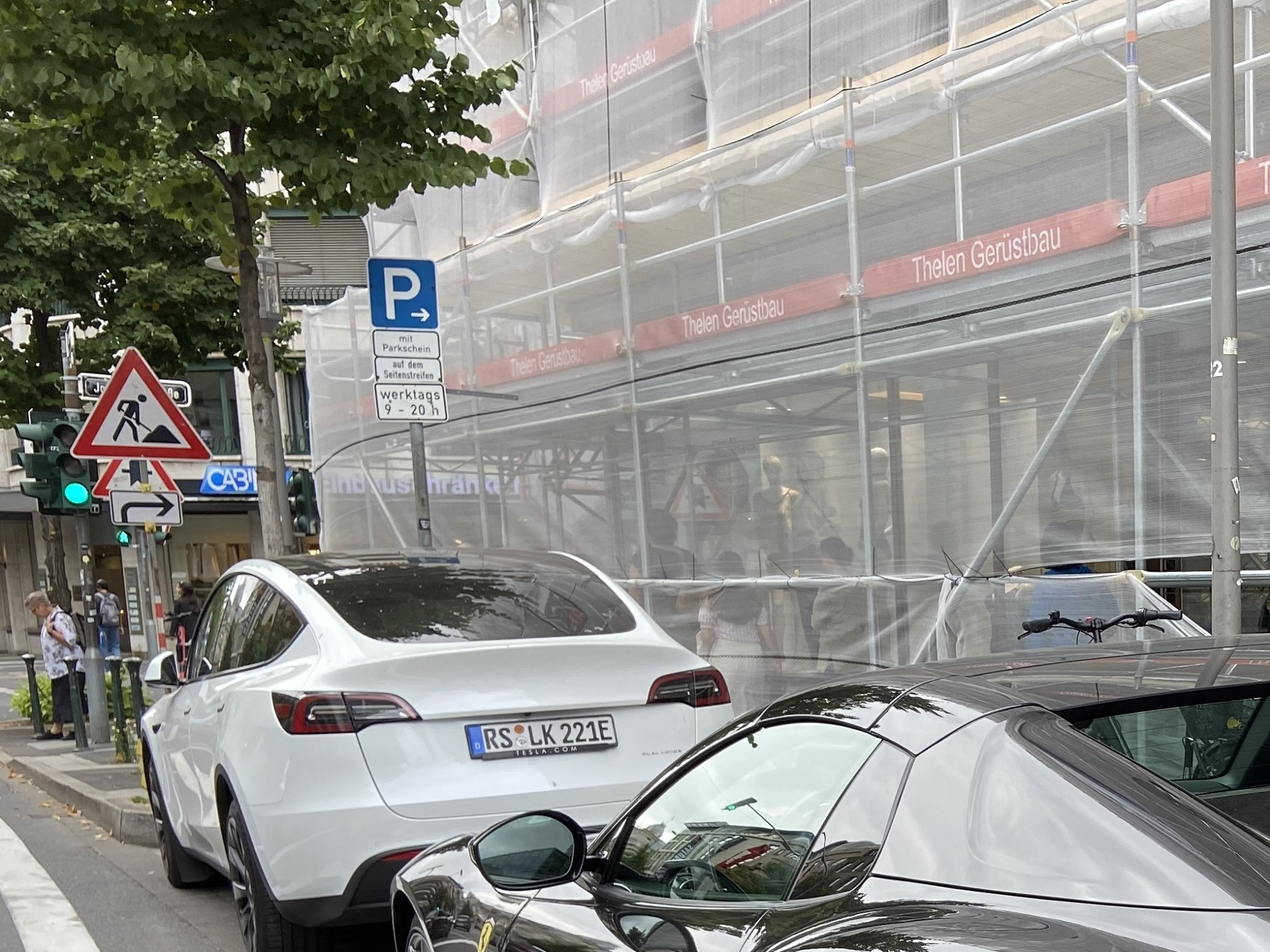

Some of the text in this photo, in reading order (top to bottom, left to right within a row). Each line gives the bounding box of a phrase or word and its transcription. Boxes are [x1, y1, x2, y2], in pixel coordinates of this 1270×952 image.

[912, 226, 1062, 283] Thelen Gerüstbau
[384, 267, 421, 320] P
[682, 297, 785, 338] Thelen Gerüstbau
[399, 335, 413, 343] mit
[382, 344, 431, 353] Parkschein
[392, 361, 424, 369] auf dem
[510, 348, 582, 377] Thelen Gerüstbau
[383, 370, 434, 380] Seitenstreifen
[380, 388, 441, 404] werktags
[384, 404, 393, 415] 9
[410, 404, 426, 415] 20
[431, 403, 439, 415] h
[483, 720, 613, 750] RS LK 221E
[474, 742, 482, 750] D
[516, 746, 578, 757] TESLA.COM
